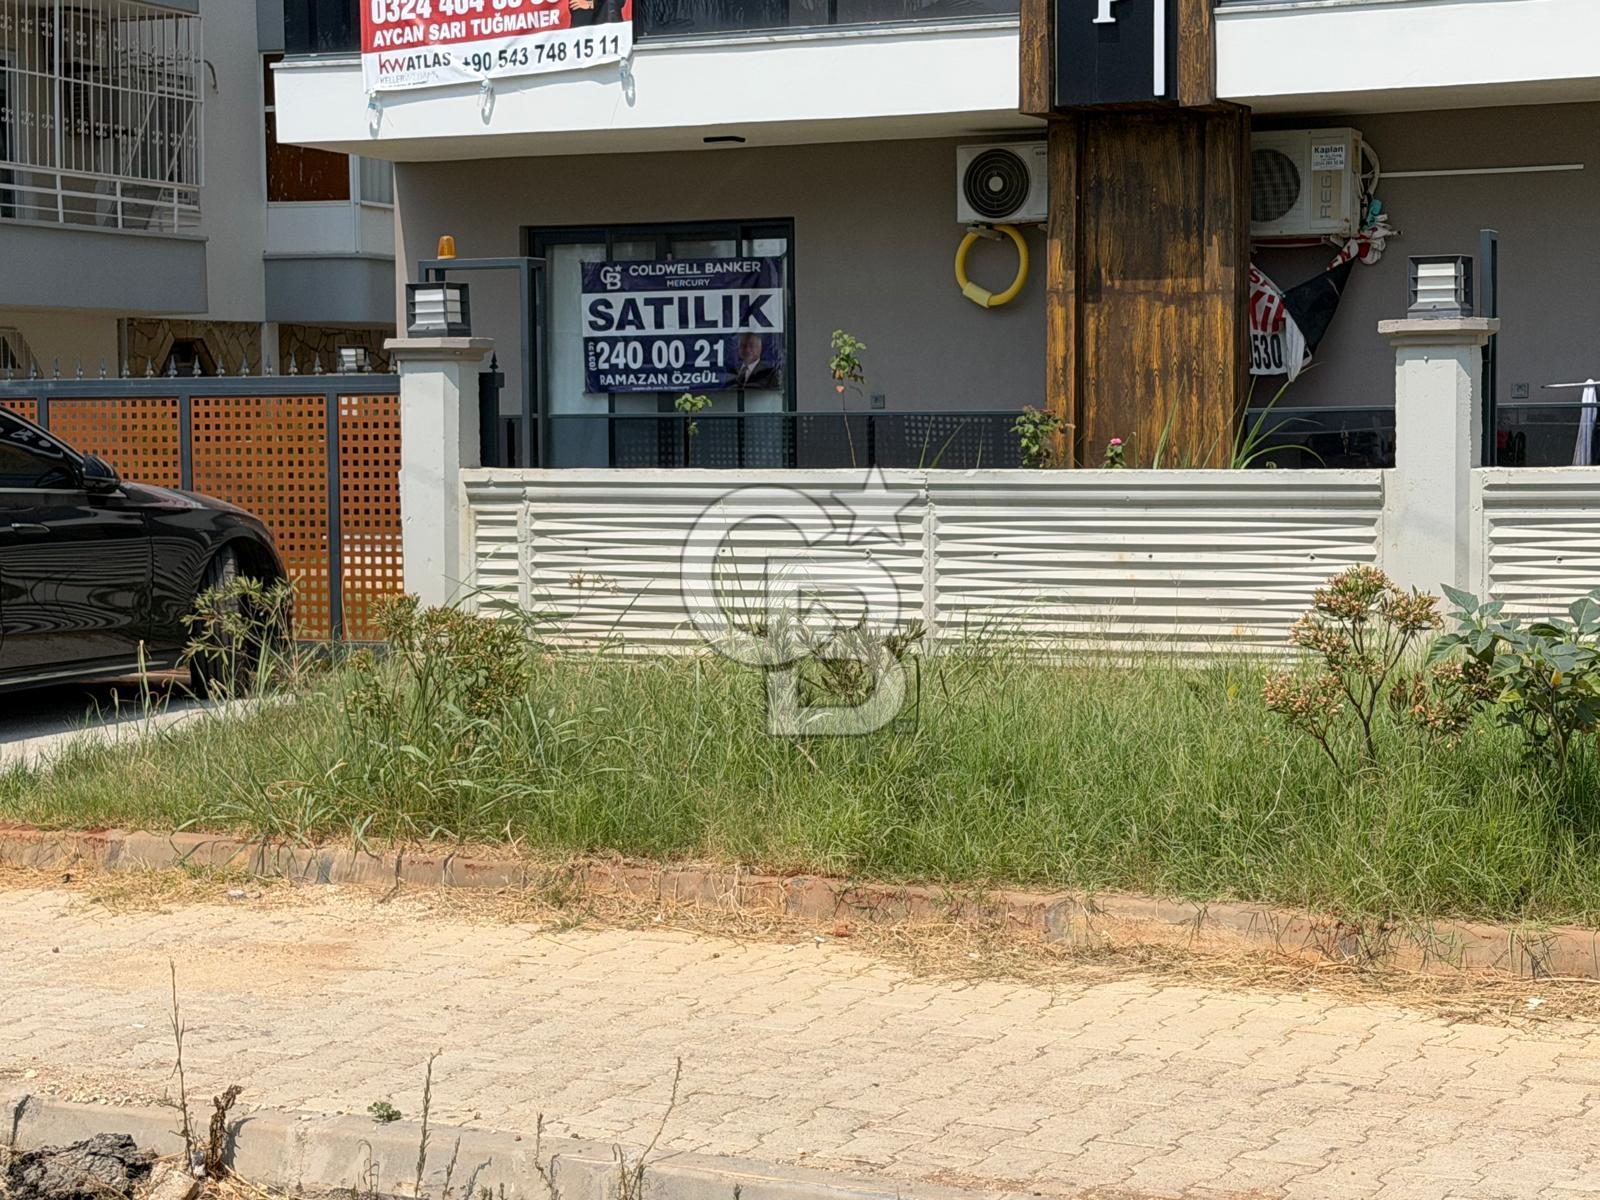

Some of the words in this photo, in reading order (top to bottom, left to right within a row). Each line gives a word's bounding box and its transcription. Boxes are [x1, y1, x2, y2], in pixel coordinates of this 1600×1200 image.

[371, 0, 432, 24] 0324
[373, 25, 425, 47] AYCAN
[429, 21, 466, 41] SARI
[471, 9, 560, 36] TUĞMANER
[462, 51, 492, 72] +90
[498, 47, 529, 68] 543
[535, 42, 567, 63] 748
[574, 38, 594, 59] 15
[600, 35, 619, 55] 11
[1314, 146, 1344, 154] Kaplan
[629, 263, 701, 277] COLDWELL
[705, 261, 761, 274] BANKER
[666, 278, 710, 288] MERCURY
[588, 294, 774, 332] SATILIK
[595, 341, 643, 370] 240
[651, 340, 685, 369] 00
[694, 339, 724, 368] 21
[600, 373, 668, 386] RAMAZAN
[671, 370, 720, 384] ÖZGÜL
